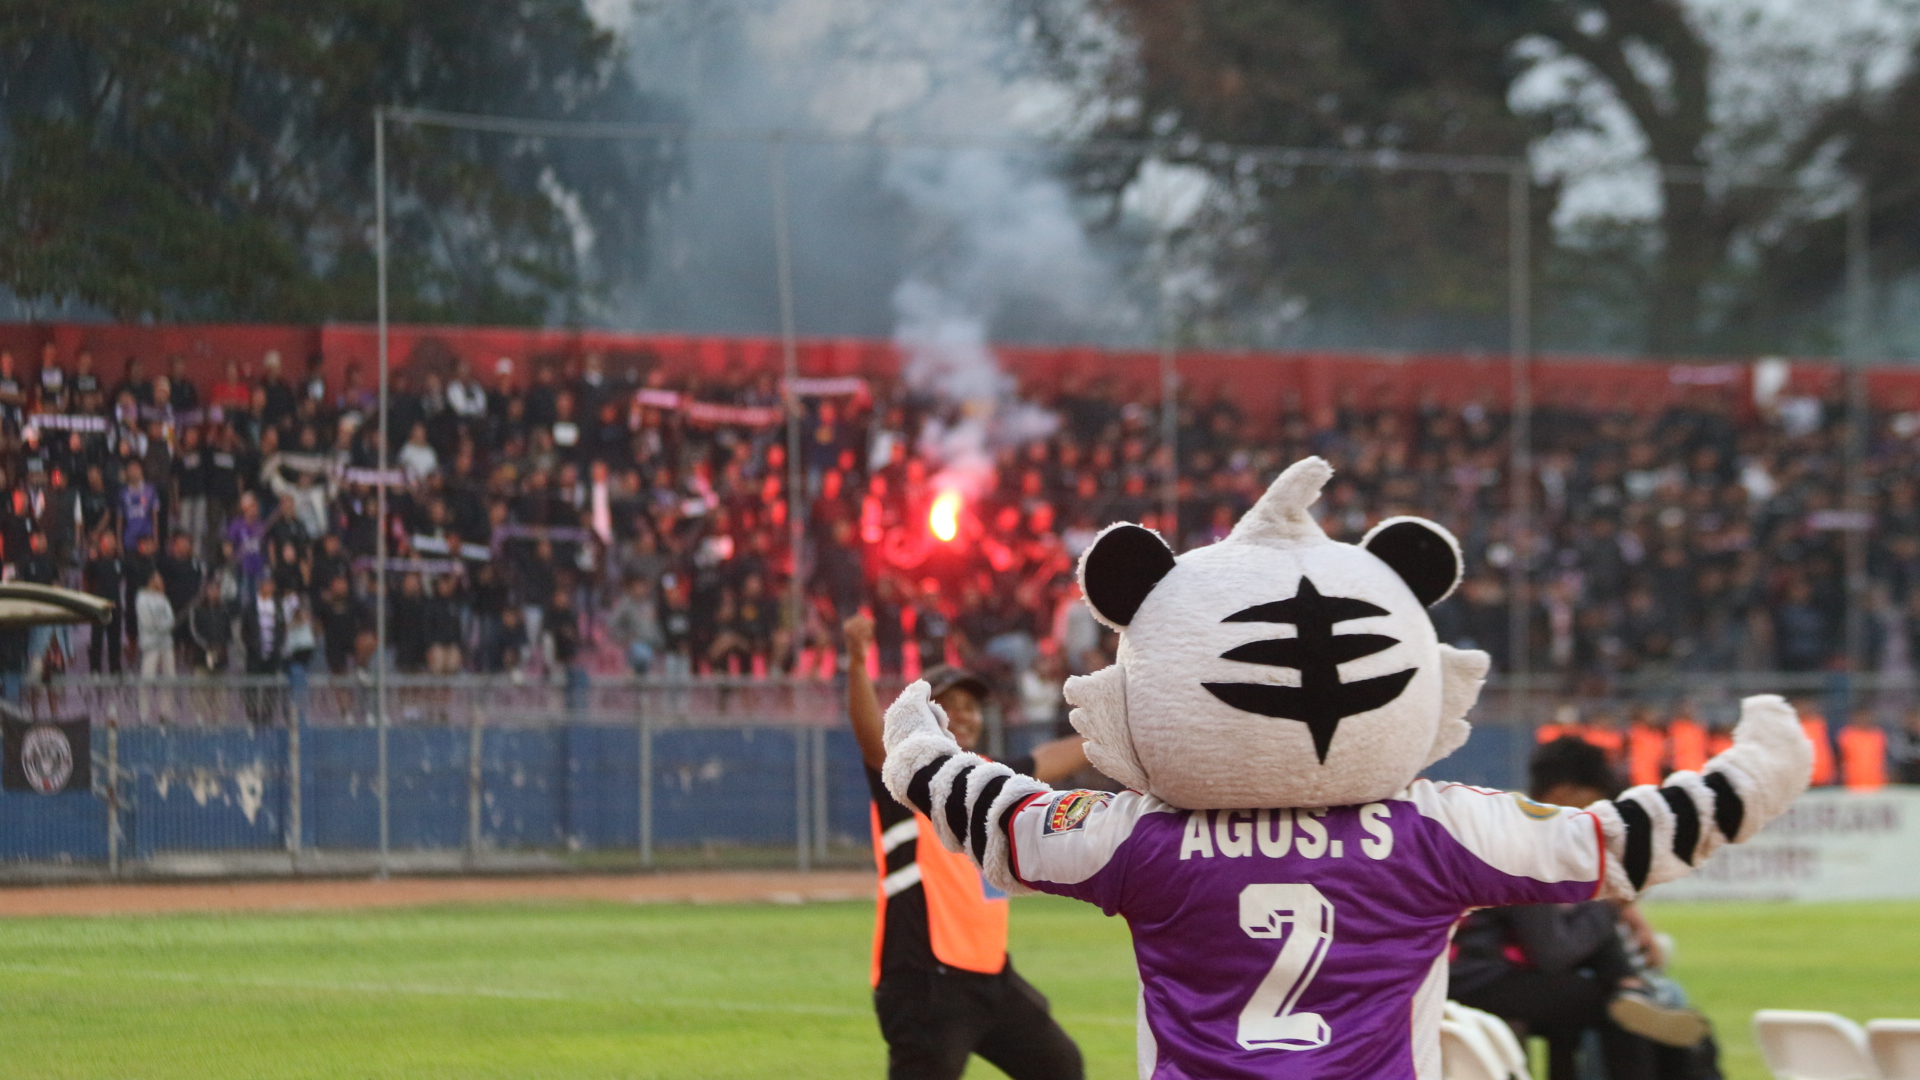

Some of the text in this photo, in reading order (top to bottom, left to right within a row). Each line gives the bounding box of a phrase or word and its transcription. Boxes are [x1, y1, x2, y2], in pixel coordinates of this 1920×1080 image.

[1179, 803, 1394, 860] AGUS. S
[1236, 884, 1335, 1051] 2
